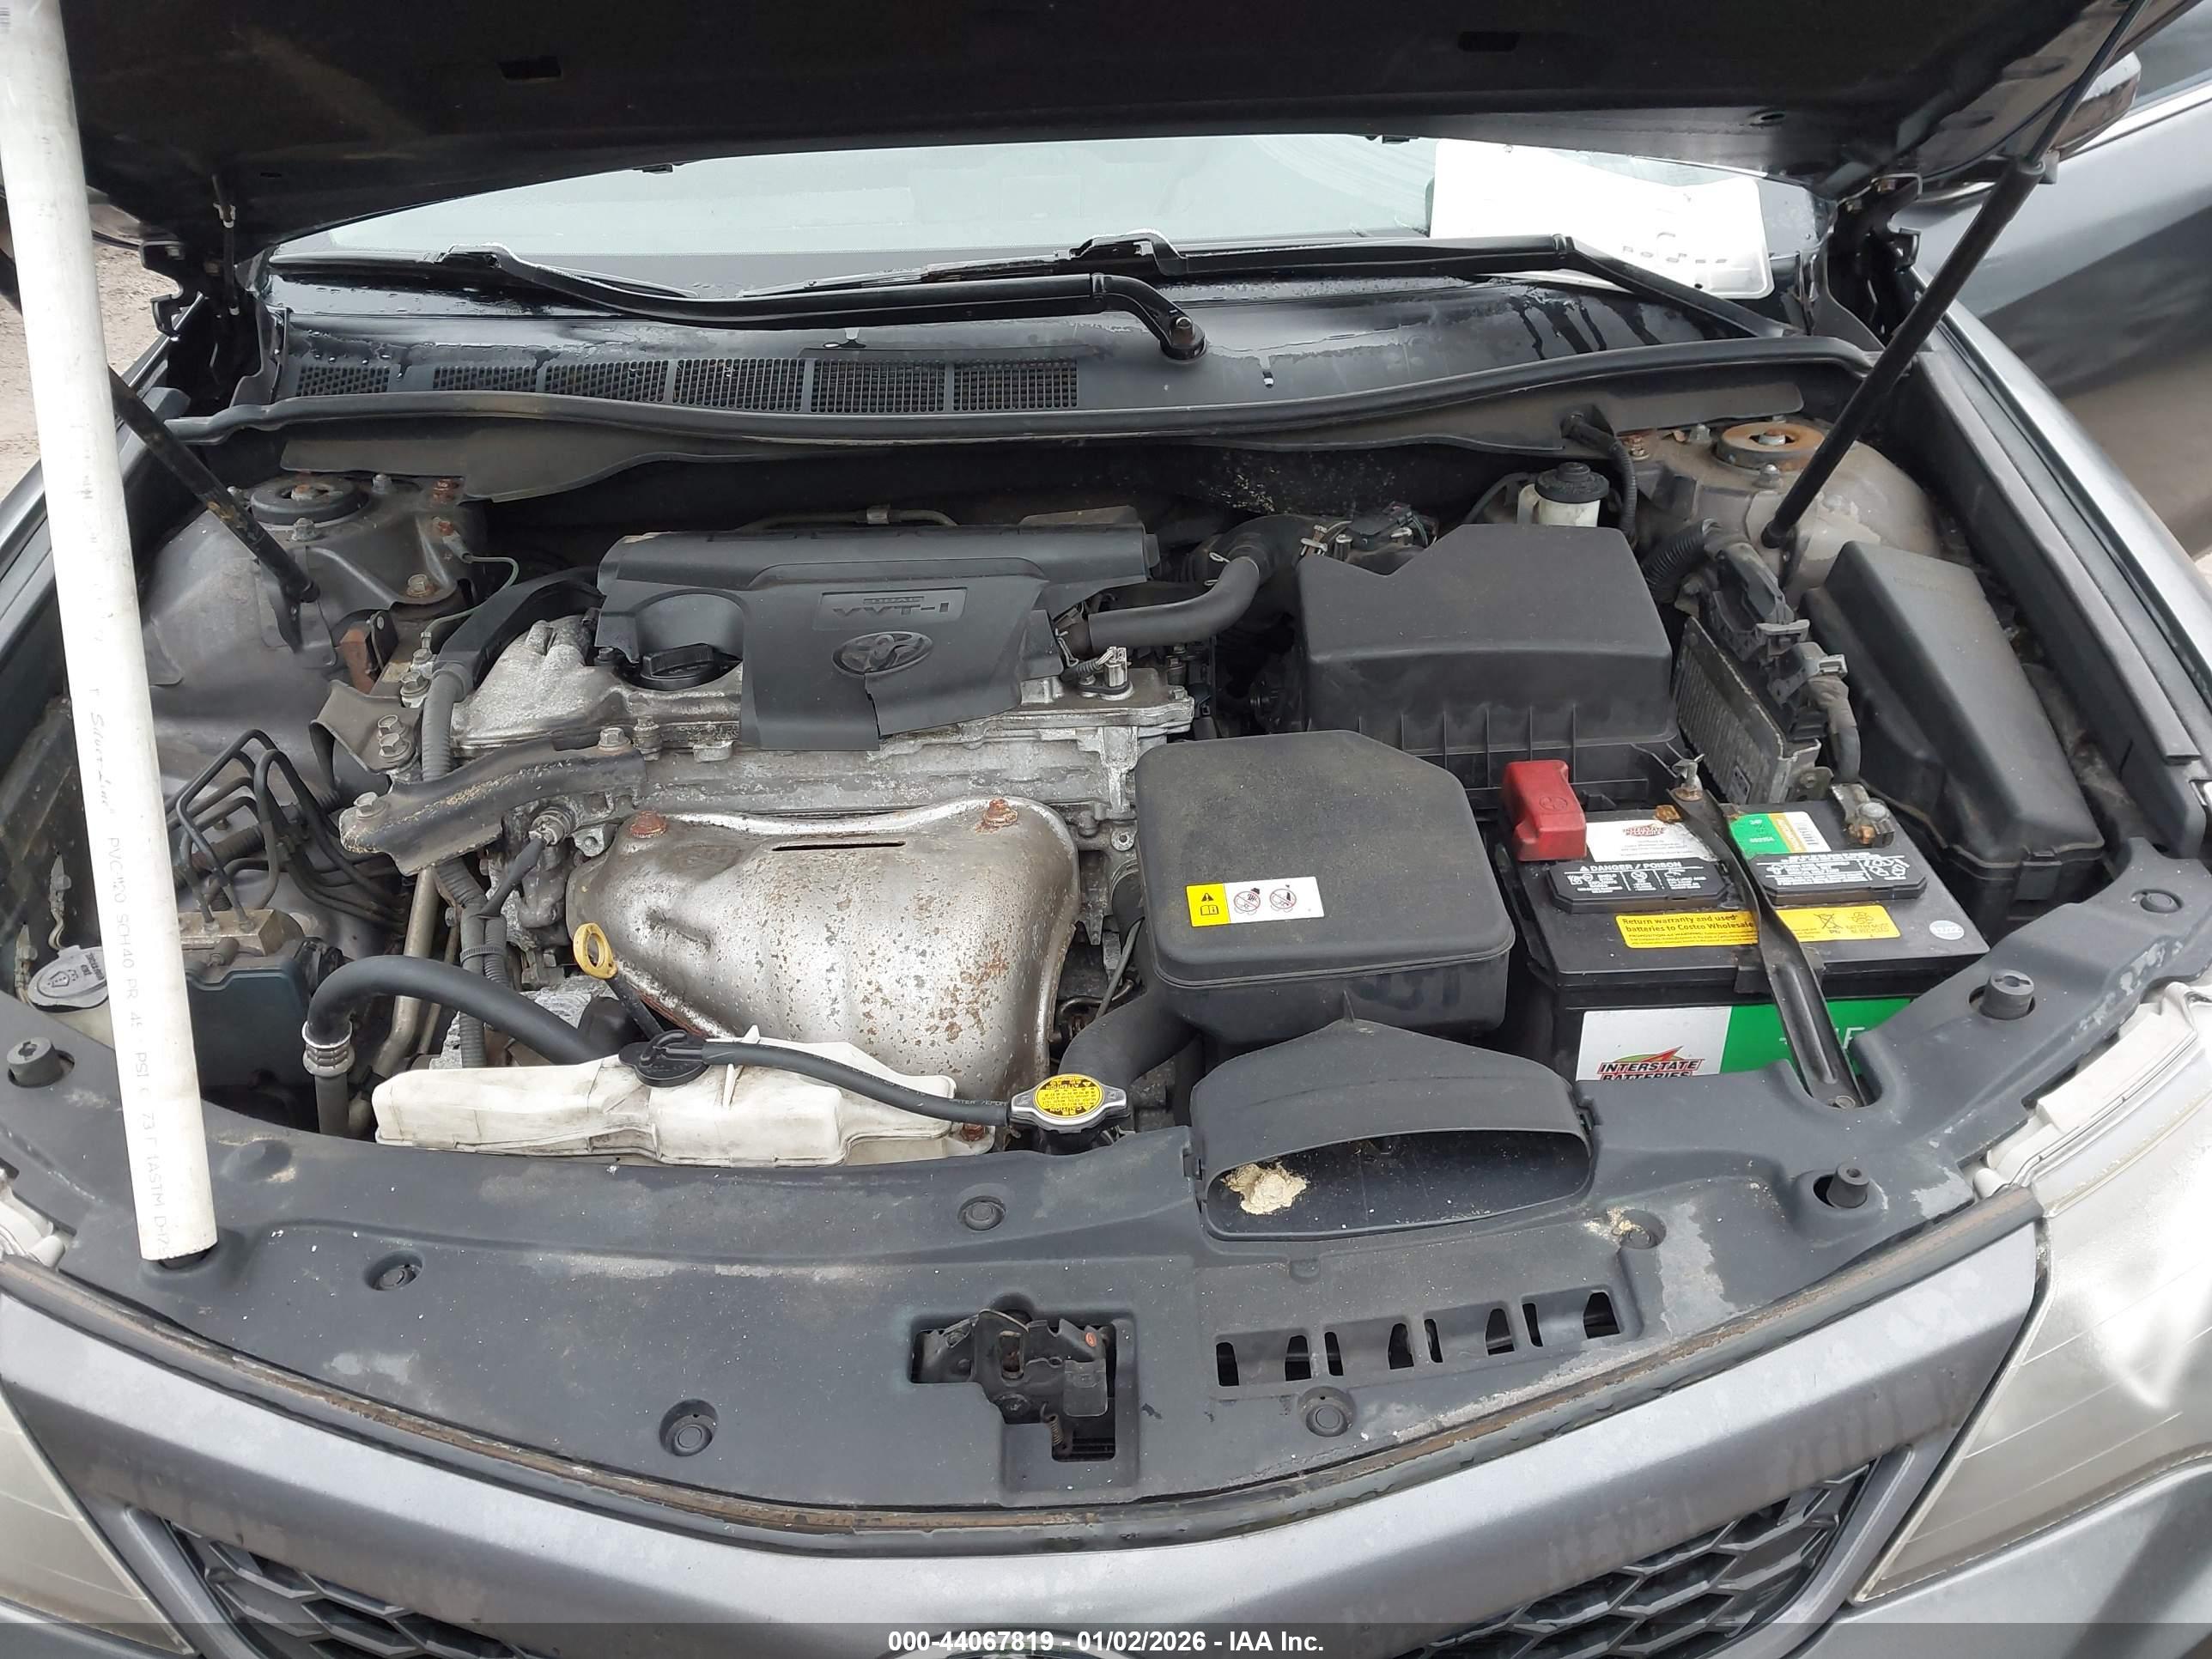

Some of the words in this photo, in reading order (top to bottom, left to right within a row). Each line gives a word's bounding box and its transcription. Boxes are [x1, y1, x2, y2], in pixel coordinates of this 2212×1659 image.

[1589, 863, 1633, 872] DANGER
[1644, 860, 1682, 870] POISON
[1706, 921, 1753, 930] Wholesale
[126, 978, 138, 1000] PR
[135, 1052, 149, 1077] PSI
[1600, 1060, 1698, 1073] INTERSTATE
